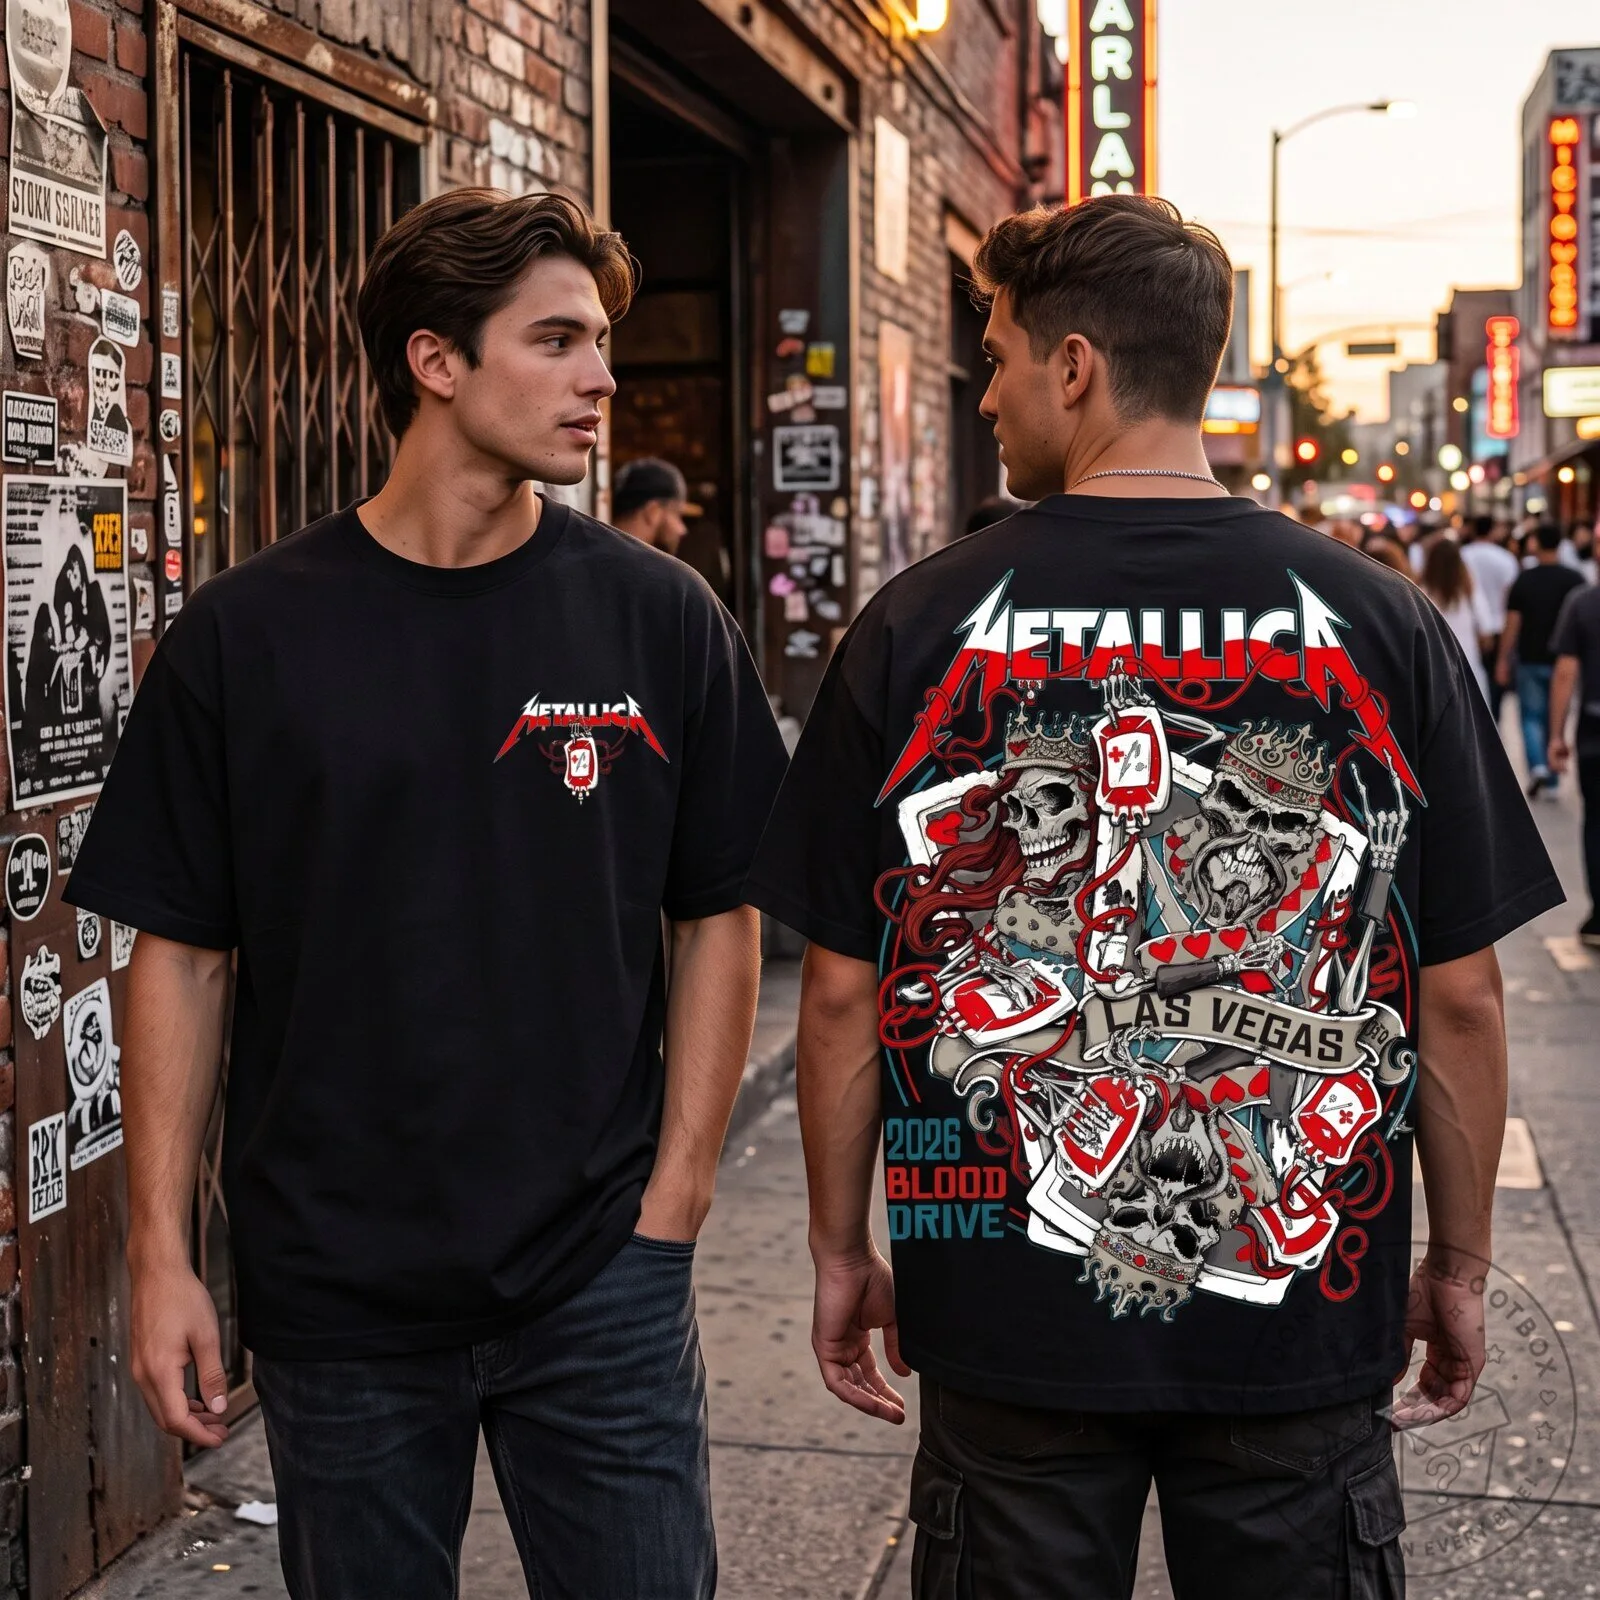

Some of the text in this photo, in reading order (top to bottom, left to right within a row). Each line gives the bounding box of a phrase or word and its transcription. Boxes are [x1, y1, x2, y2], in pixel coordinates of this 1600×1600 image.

[1089, 0, 1135, 197] ARLA
[875, 569, 1427, 807] METALLICA
[493, 691, 670, 763] METALLICA
[1103, 994, 1344, 1063] LAS VEGAS
[886, 1118, 961, 1161] 2026
[887, 1166, 1007, 1199] BLOOD
[888, 1204, 1005, 1240] DRIVE
